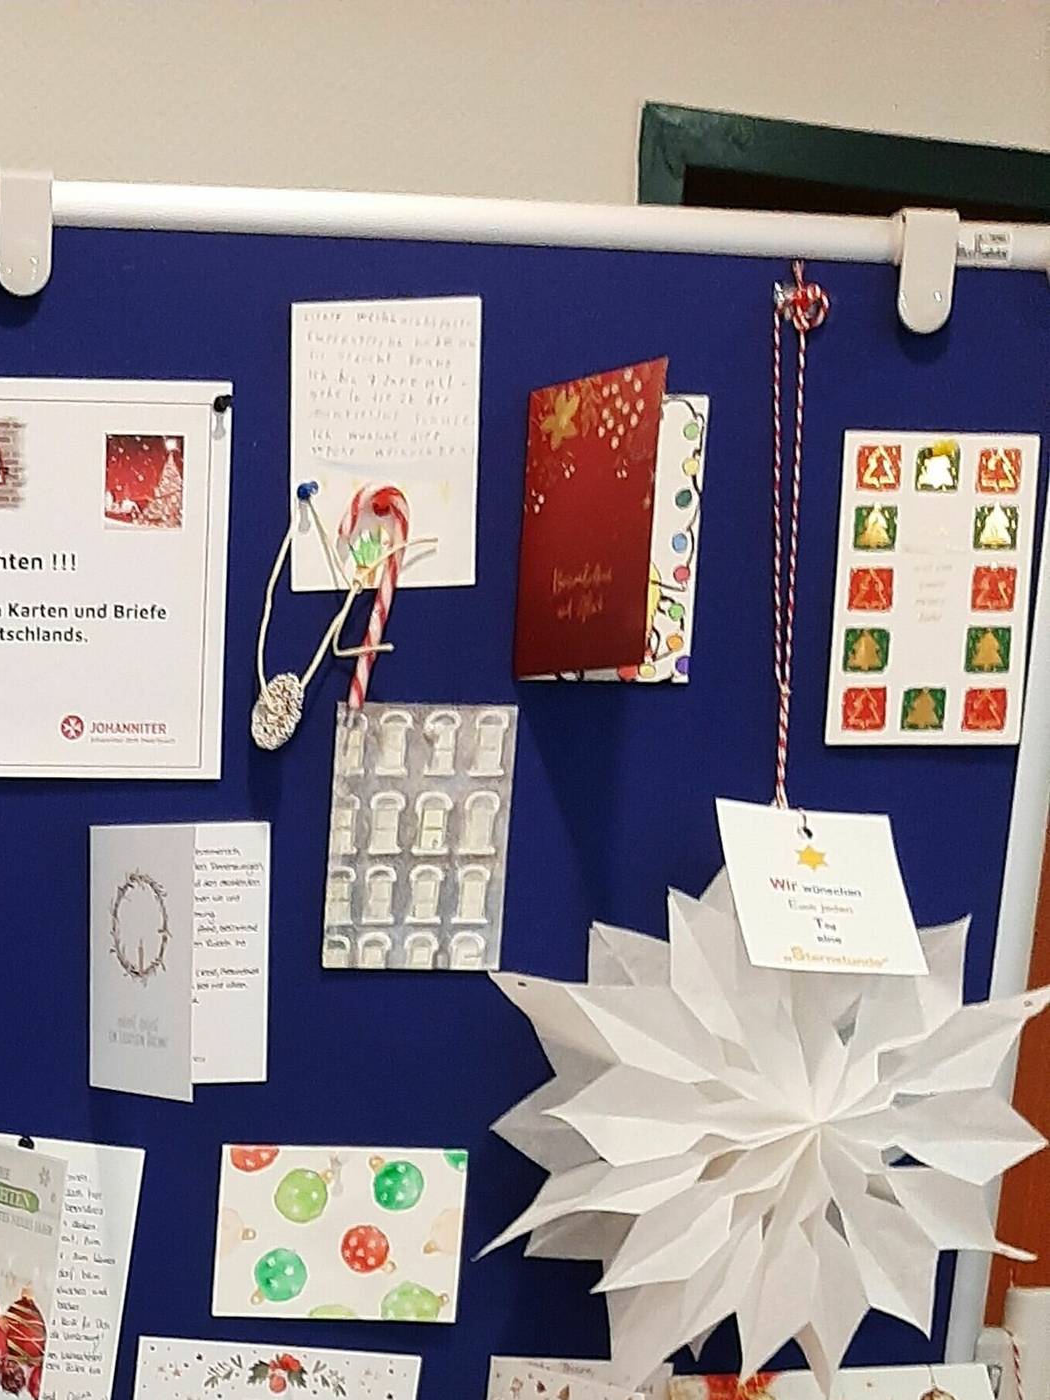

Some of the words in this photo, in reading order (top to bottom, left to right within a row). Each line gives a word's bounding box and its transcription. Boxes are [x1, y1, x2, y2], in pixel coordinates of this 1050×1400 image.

[51, 553, 77, 571] !!!
[8, 602, 68, 618] Karten
[74, 604, 107, 619] und
[114, 604, 167, 619] Briefe
[90, 721, 167, 735] JOHANNITER
[769, 877, 798, 893] Wir
